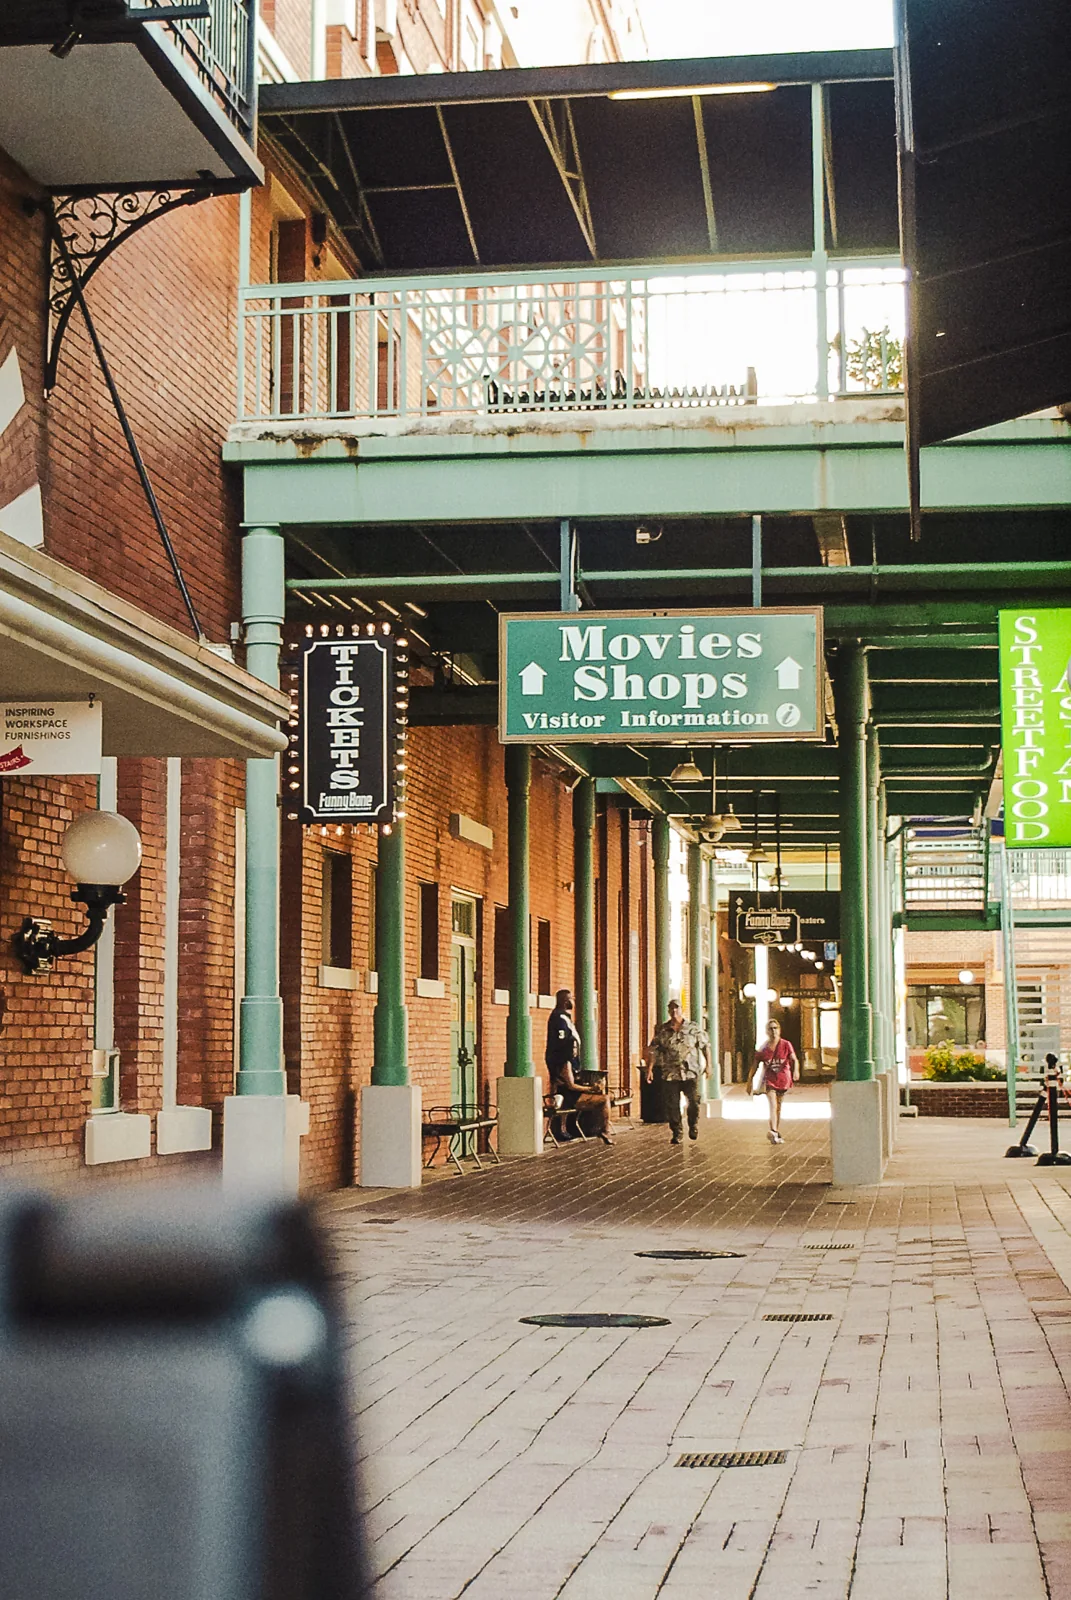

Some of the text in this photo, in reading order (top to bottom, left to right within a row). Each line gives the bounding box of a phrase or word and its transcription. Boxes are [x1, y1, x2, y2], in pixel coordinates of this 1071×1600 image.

[558, 625, 762, 661] Movies
[573, 664, 748, 708] Shops
[5, 708, 55, 717] INSPIRING
[326, 645, 364, 790] TICKETS
[522, 709, 769, 729] Visitor Information
[5, 719, 67, 729] WORKSPACE
[5, 731, 71, 740] FURNISHINGS
